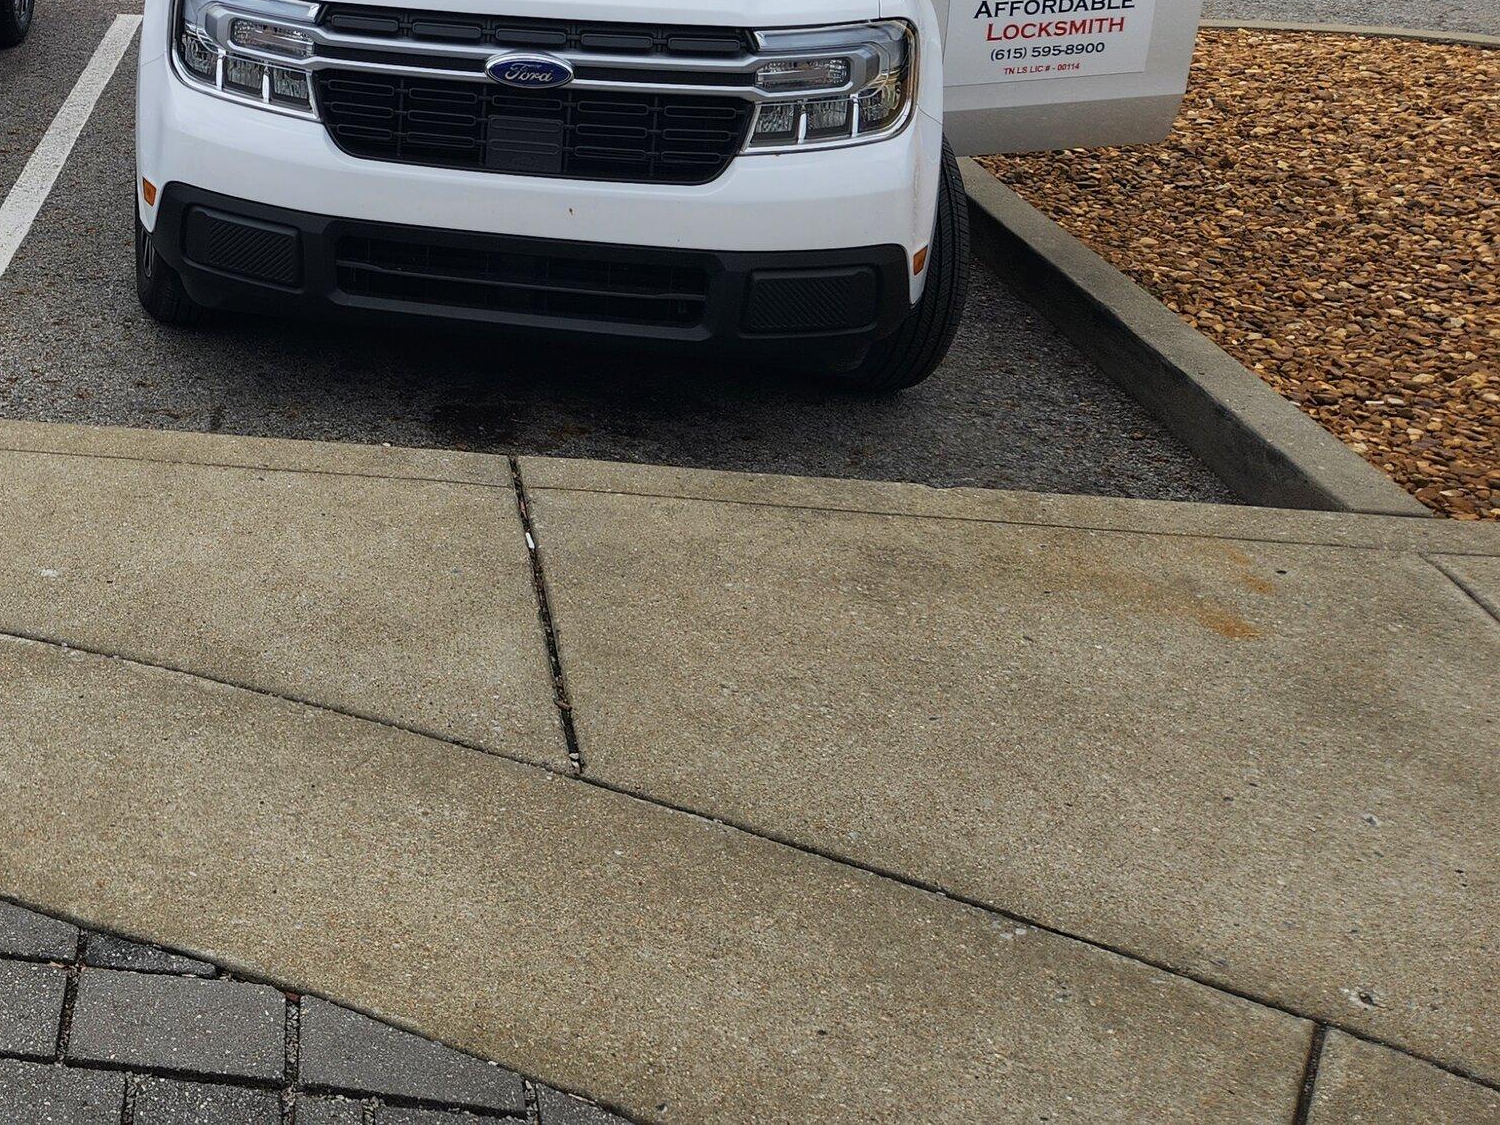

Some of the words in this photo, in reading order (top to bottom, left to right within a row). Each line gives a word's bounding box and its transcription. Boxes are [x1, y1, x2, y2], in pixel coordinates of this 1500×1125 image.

[986, 16, 1125, 41] LOCKSMITH
[990, 46, 1027, 62] (615)
[1031, 42, 1105, 58] 595-8900
[505, 62, 554, 83] Ford
[1003, 67, 1015, 75] TN
[1016, 66, 1028, 74] LS
